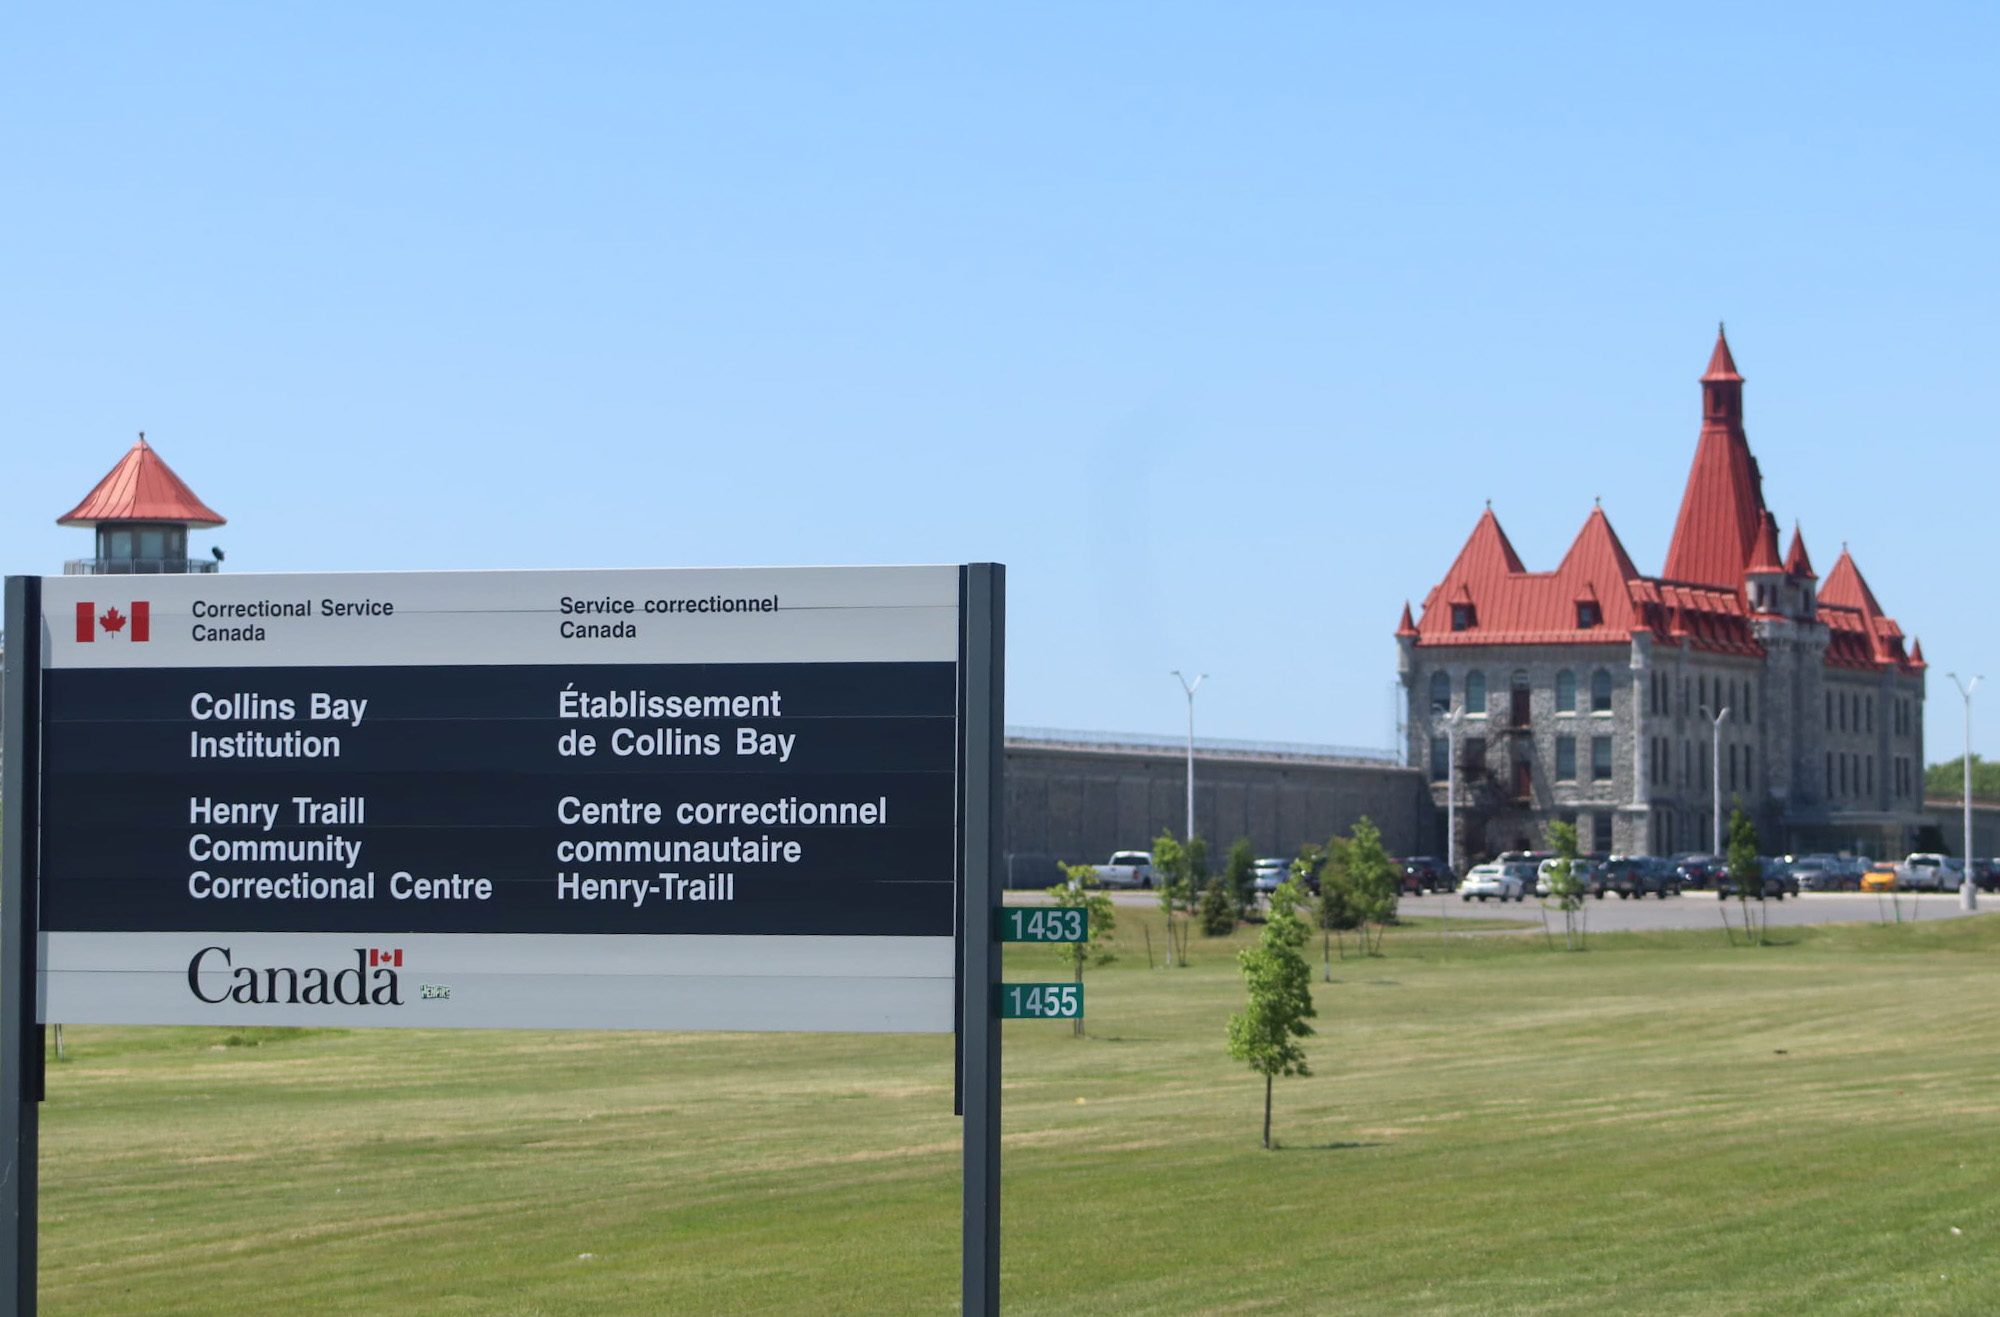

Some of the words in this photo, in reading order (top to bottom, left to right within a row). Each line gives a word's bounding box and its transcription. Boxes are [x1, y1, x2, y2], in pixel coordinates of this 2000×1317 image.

[192, 599, 311, 618] Correctional
[321, 598, 394, 617] Service
[560, 596, 635, 615] Service
[644, 594, 779, 614] correctionnel
[191, 623, 265, 642] Canada
[560, 620, 636, 639] Canada
[190, 692, 296, 721] Collins
[310, 692, 368, 727] Bay
[559, 682, 782, 719] Établissement
[191, 730, 340, 758] Institution
[558, 728, 597, 757] de
[611, 727, 721, 756] Collins
[736, 727, 796, 763] Bay
[190, 796, 279, 831] Henry
[292, 796, 365, 825] Traill
[557, 796, 662, 825] Centre
[676, 796, 886, 825] correctionnel
[189, 833, 362, 868] Community
[556, 834, 802, 863] communautaire
[188, 870, 375, 900] Correctional
[390, 871, 493, 900] Centre
[557, 872, 734, 907] Henry-Traill
[1010, 910, 1082, 941] 1453
[187, 946, 405, 1006] Canada
[1010, 986, 1078, 1017] 1455
